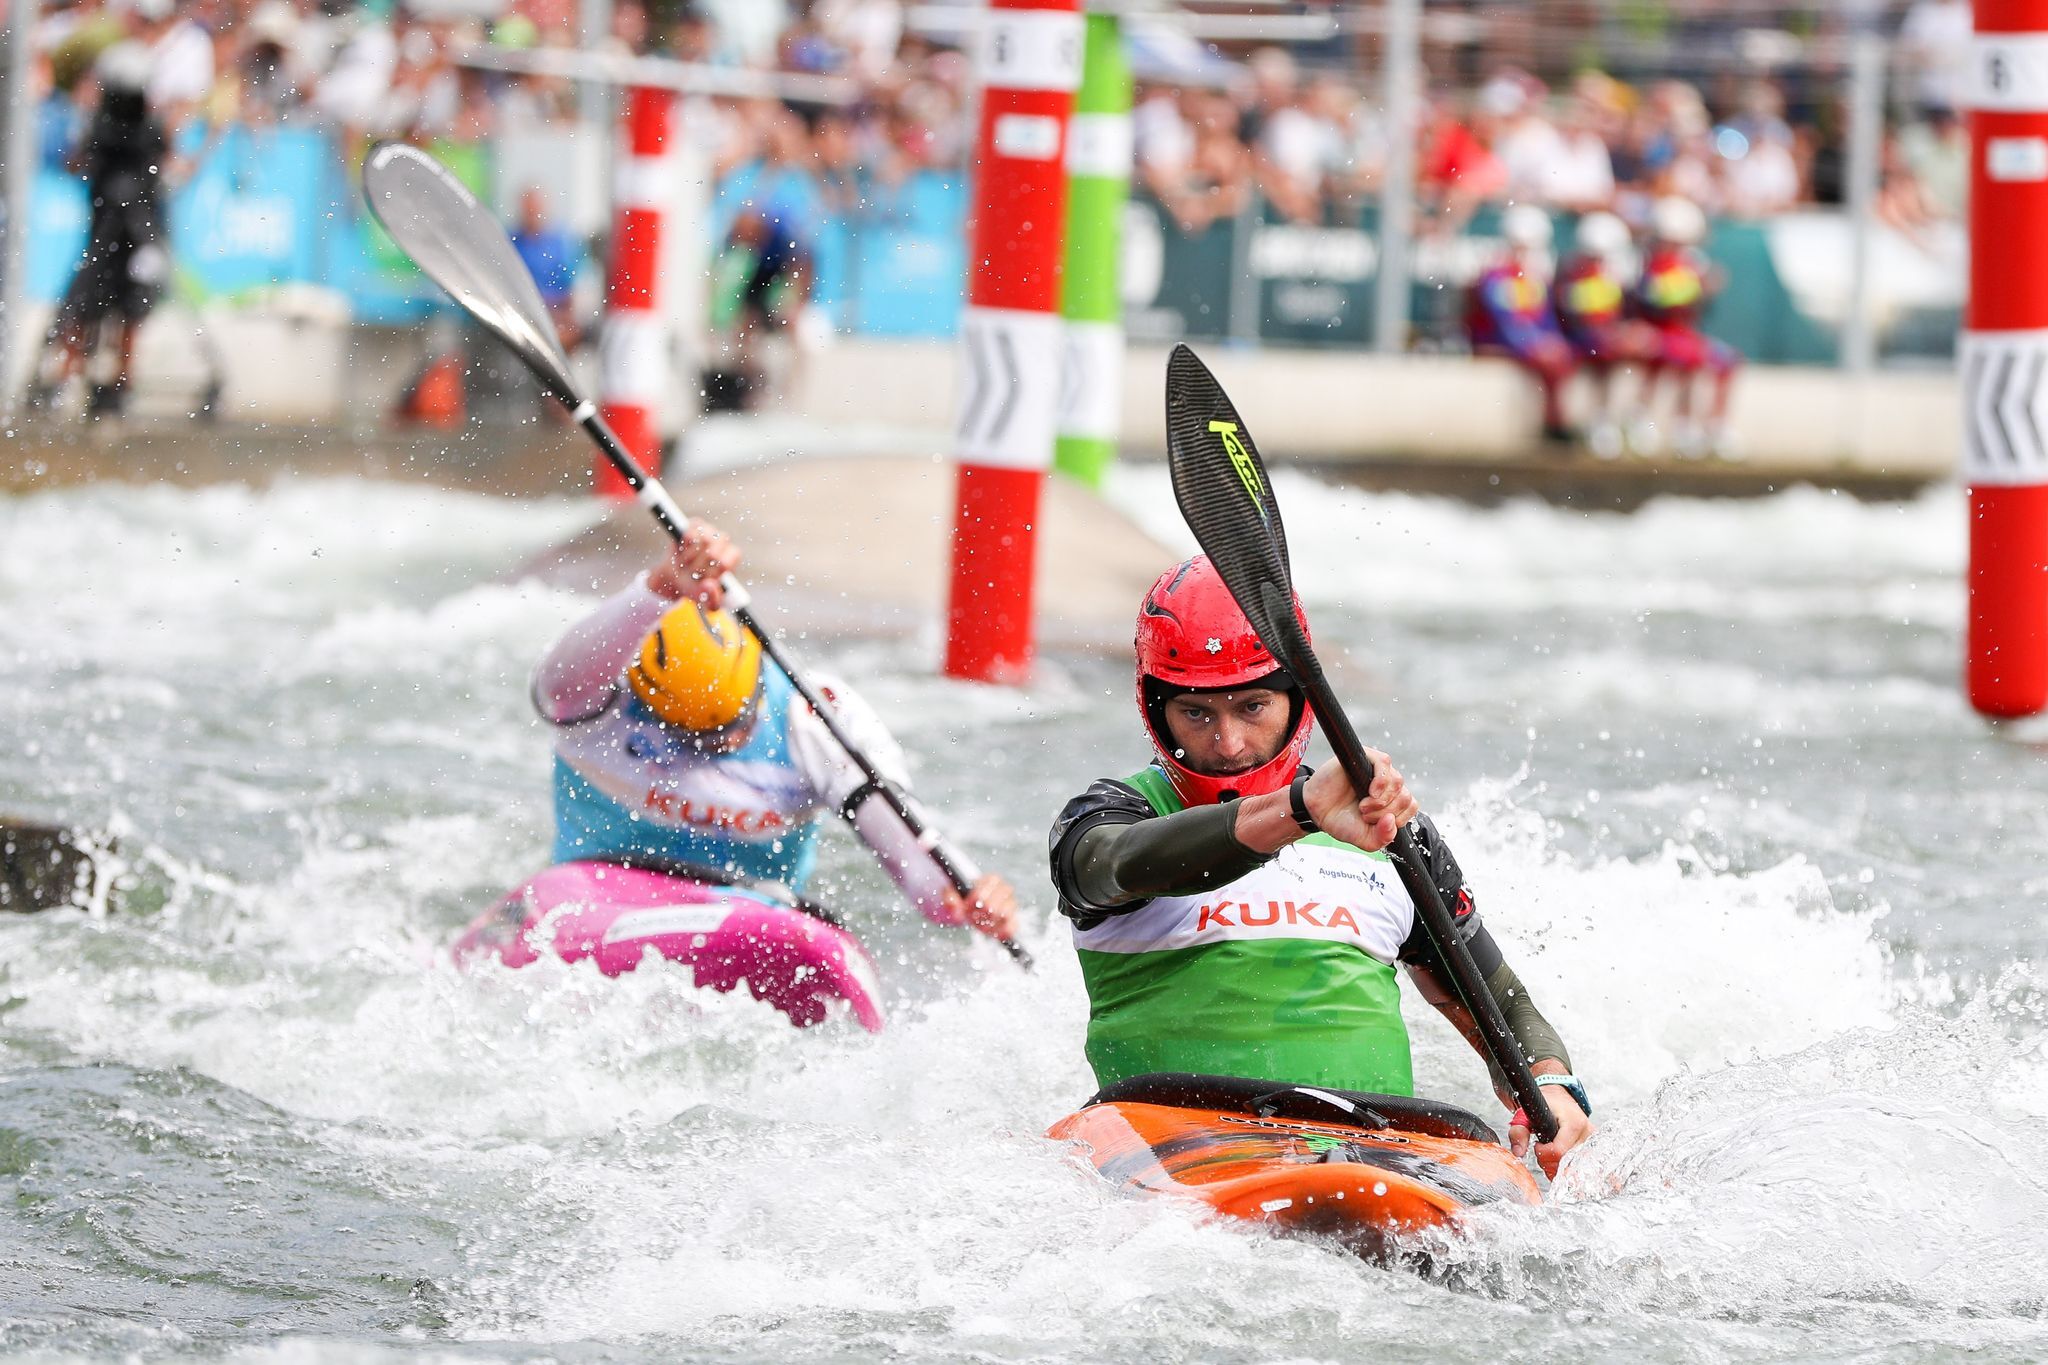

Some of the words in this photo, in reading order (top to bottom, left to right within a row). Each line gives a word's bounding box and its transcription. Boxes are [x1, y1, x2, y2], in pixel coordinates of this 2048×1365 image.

[643, 788, 783, 833] KUKA
[1319, 867, 1363, 883] Augsburg
[1196, 900, 1361, 937] KUKA
